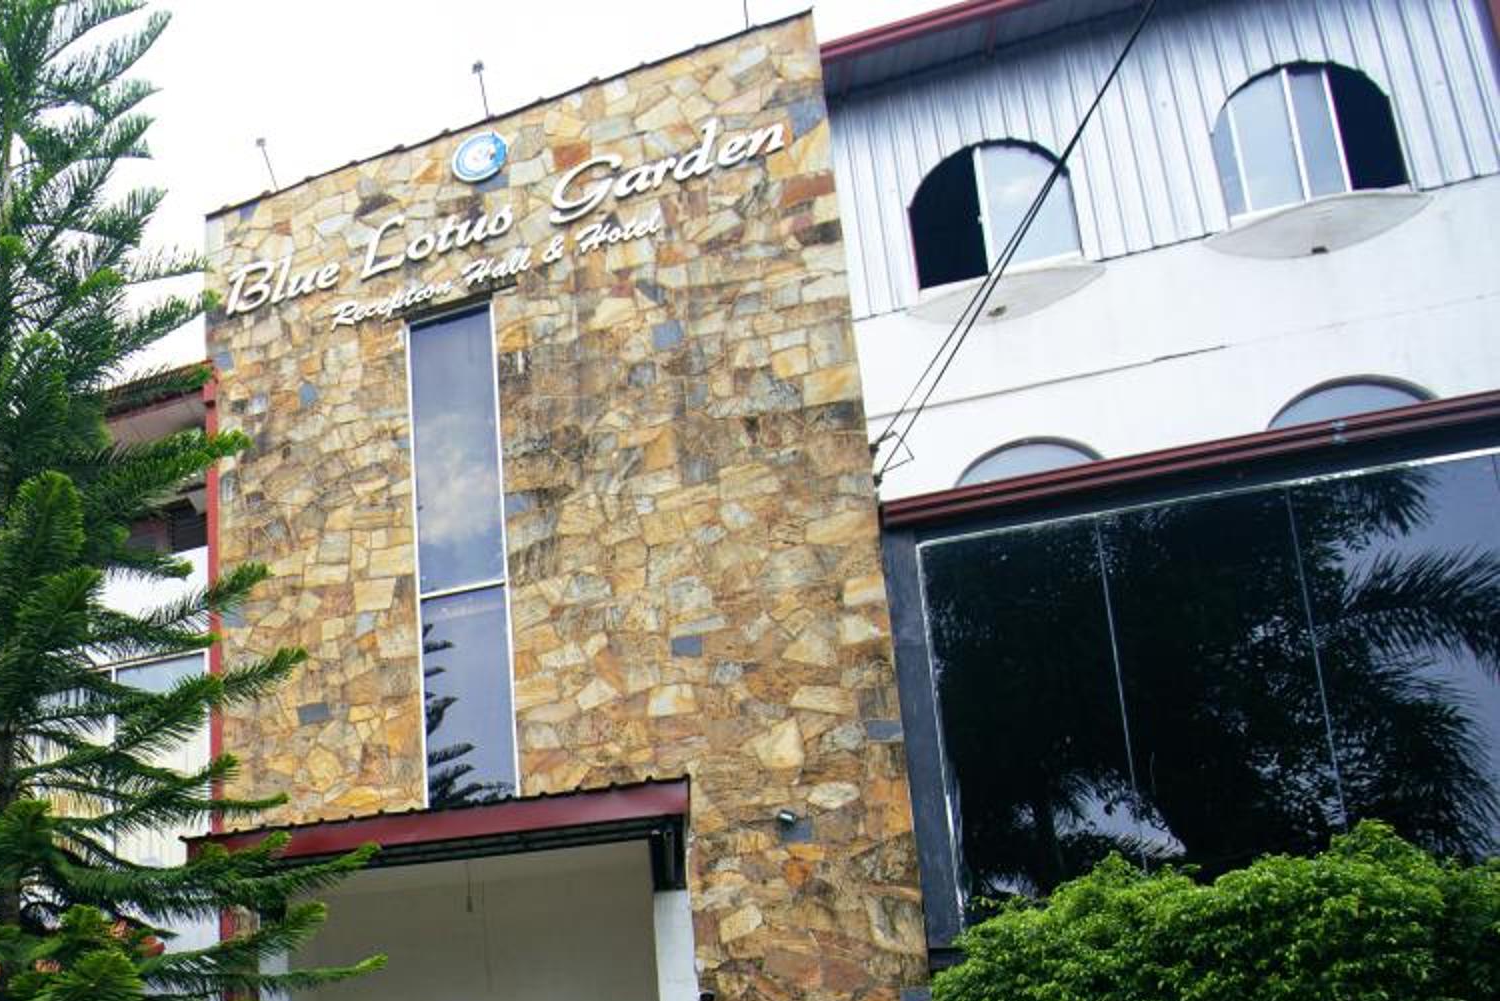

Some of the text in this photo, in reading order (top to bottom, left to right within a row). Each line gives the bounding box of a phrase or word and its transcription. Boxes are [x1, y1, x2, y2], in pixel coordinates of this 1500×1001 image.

[227, 117, 786, 316] Blue Lotus Garden
[331, 212, 660, 330] Reception Hall & Hotel
